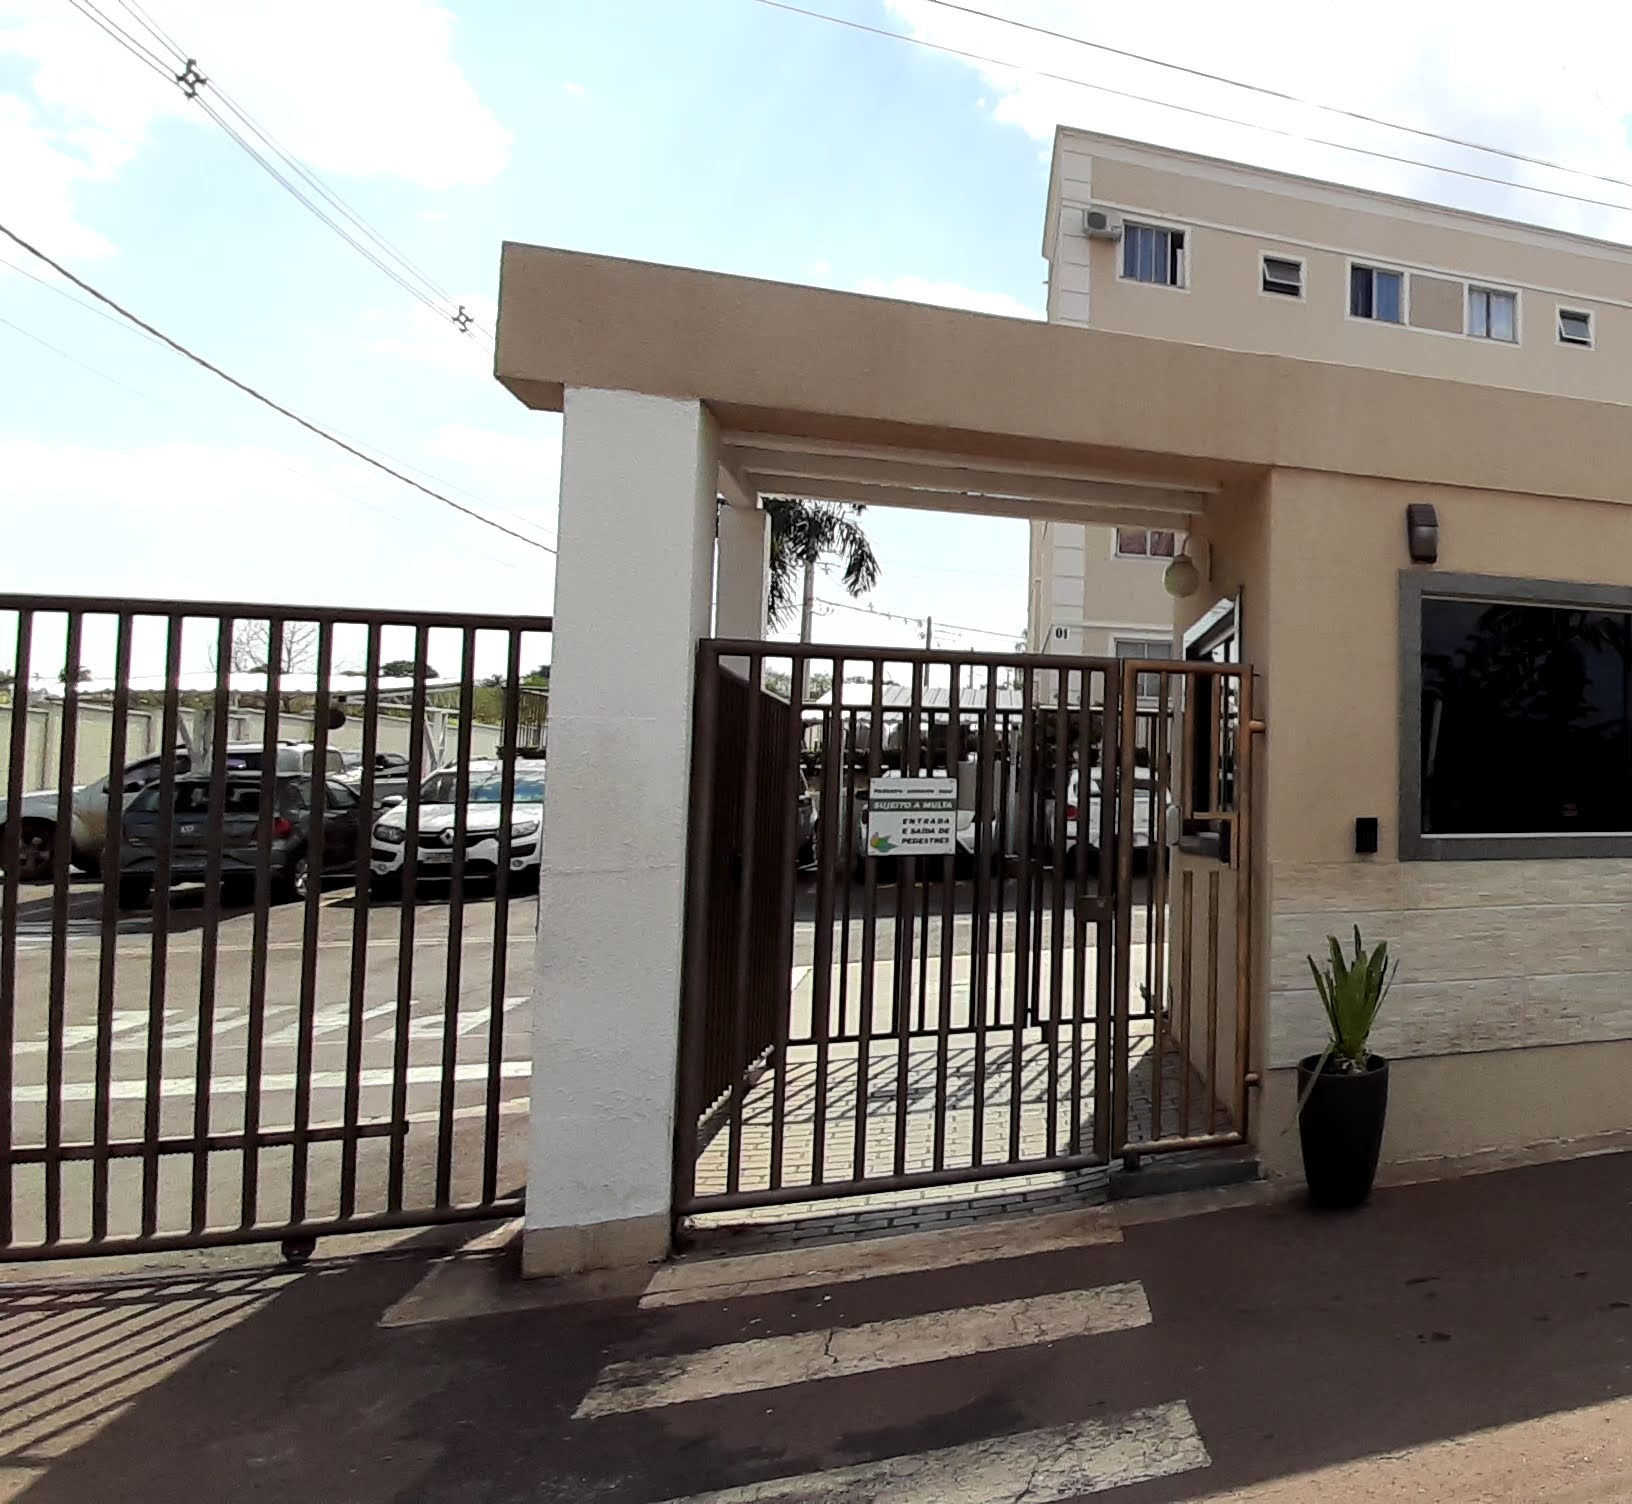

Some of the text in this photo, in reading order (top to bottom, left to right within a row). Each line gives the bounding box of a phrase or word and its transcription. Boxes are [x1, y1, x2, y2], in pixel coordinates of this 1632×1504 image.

[1056, 627, 1068, 639] 01
[874, 800, 953, 810] SUJEITO A MULTA
